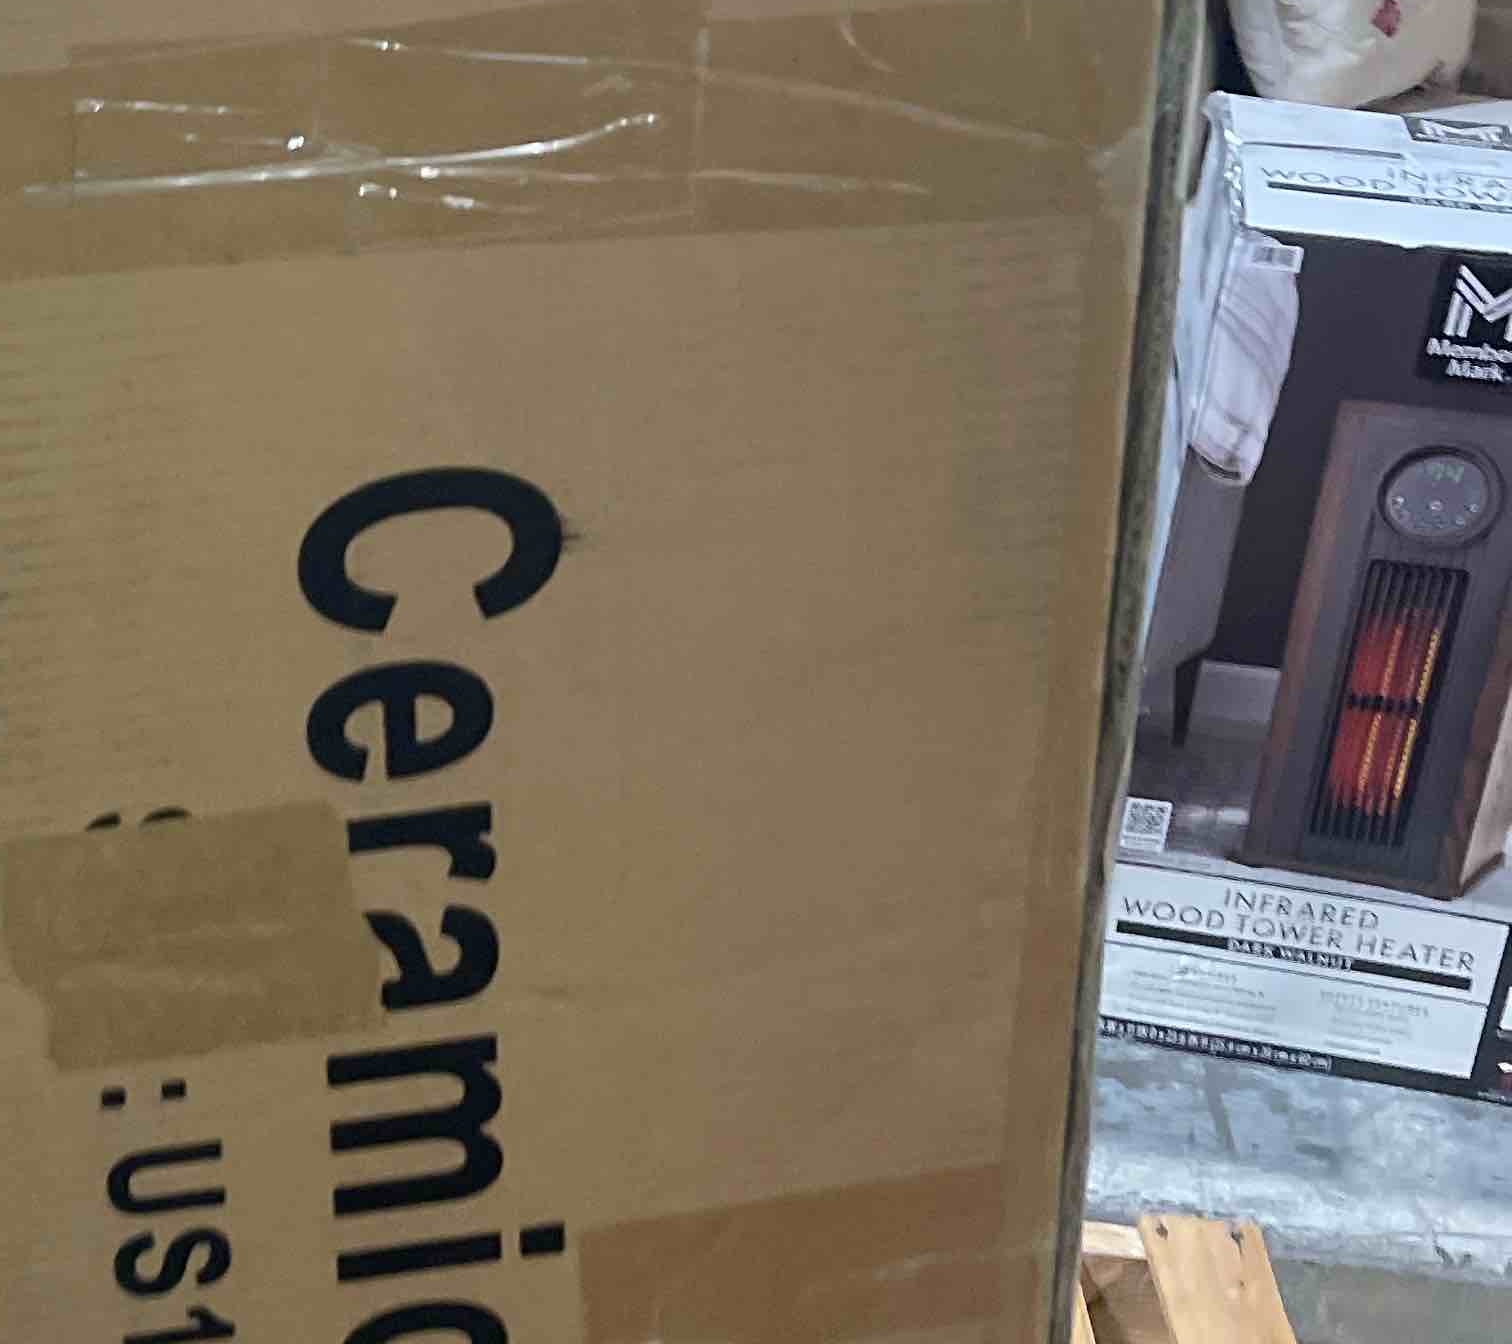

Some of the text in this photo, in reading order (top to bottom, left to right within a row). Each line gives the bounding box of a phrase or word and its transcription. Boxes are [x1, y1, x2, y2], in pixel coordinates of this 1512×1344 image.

[1261, 167, 1395, 191] WOOD
[1224, 886, 1379, 931] INFRARED
[1122, 895, 1476, 974] WOOD TOWER HEATER
